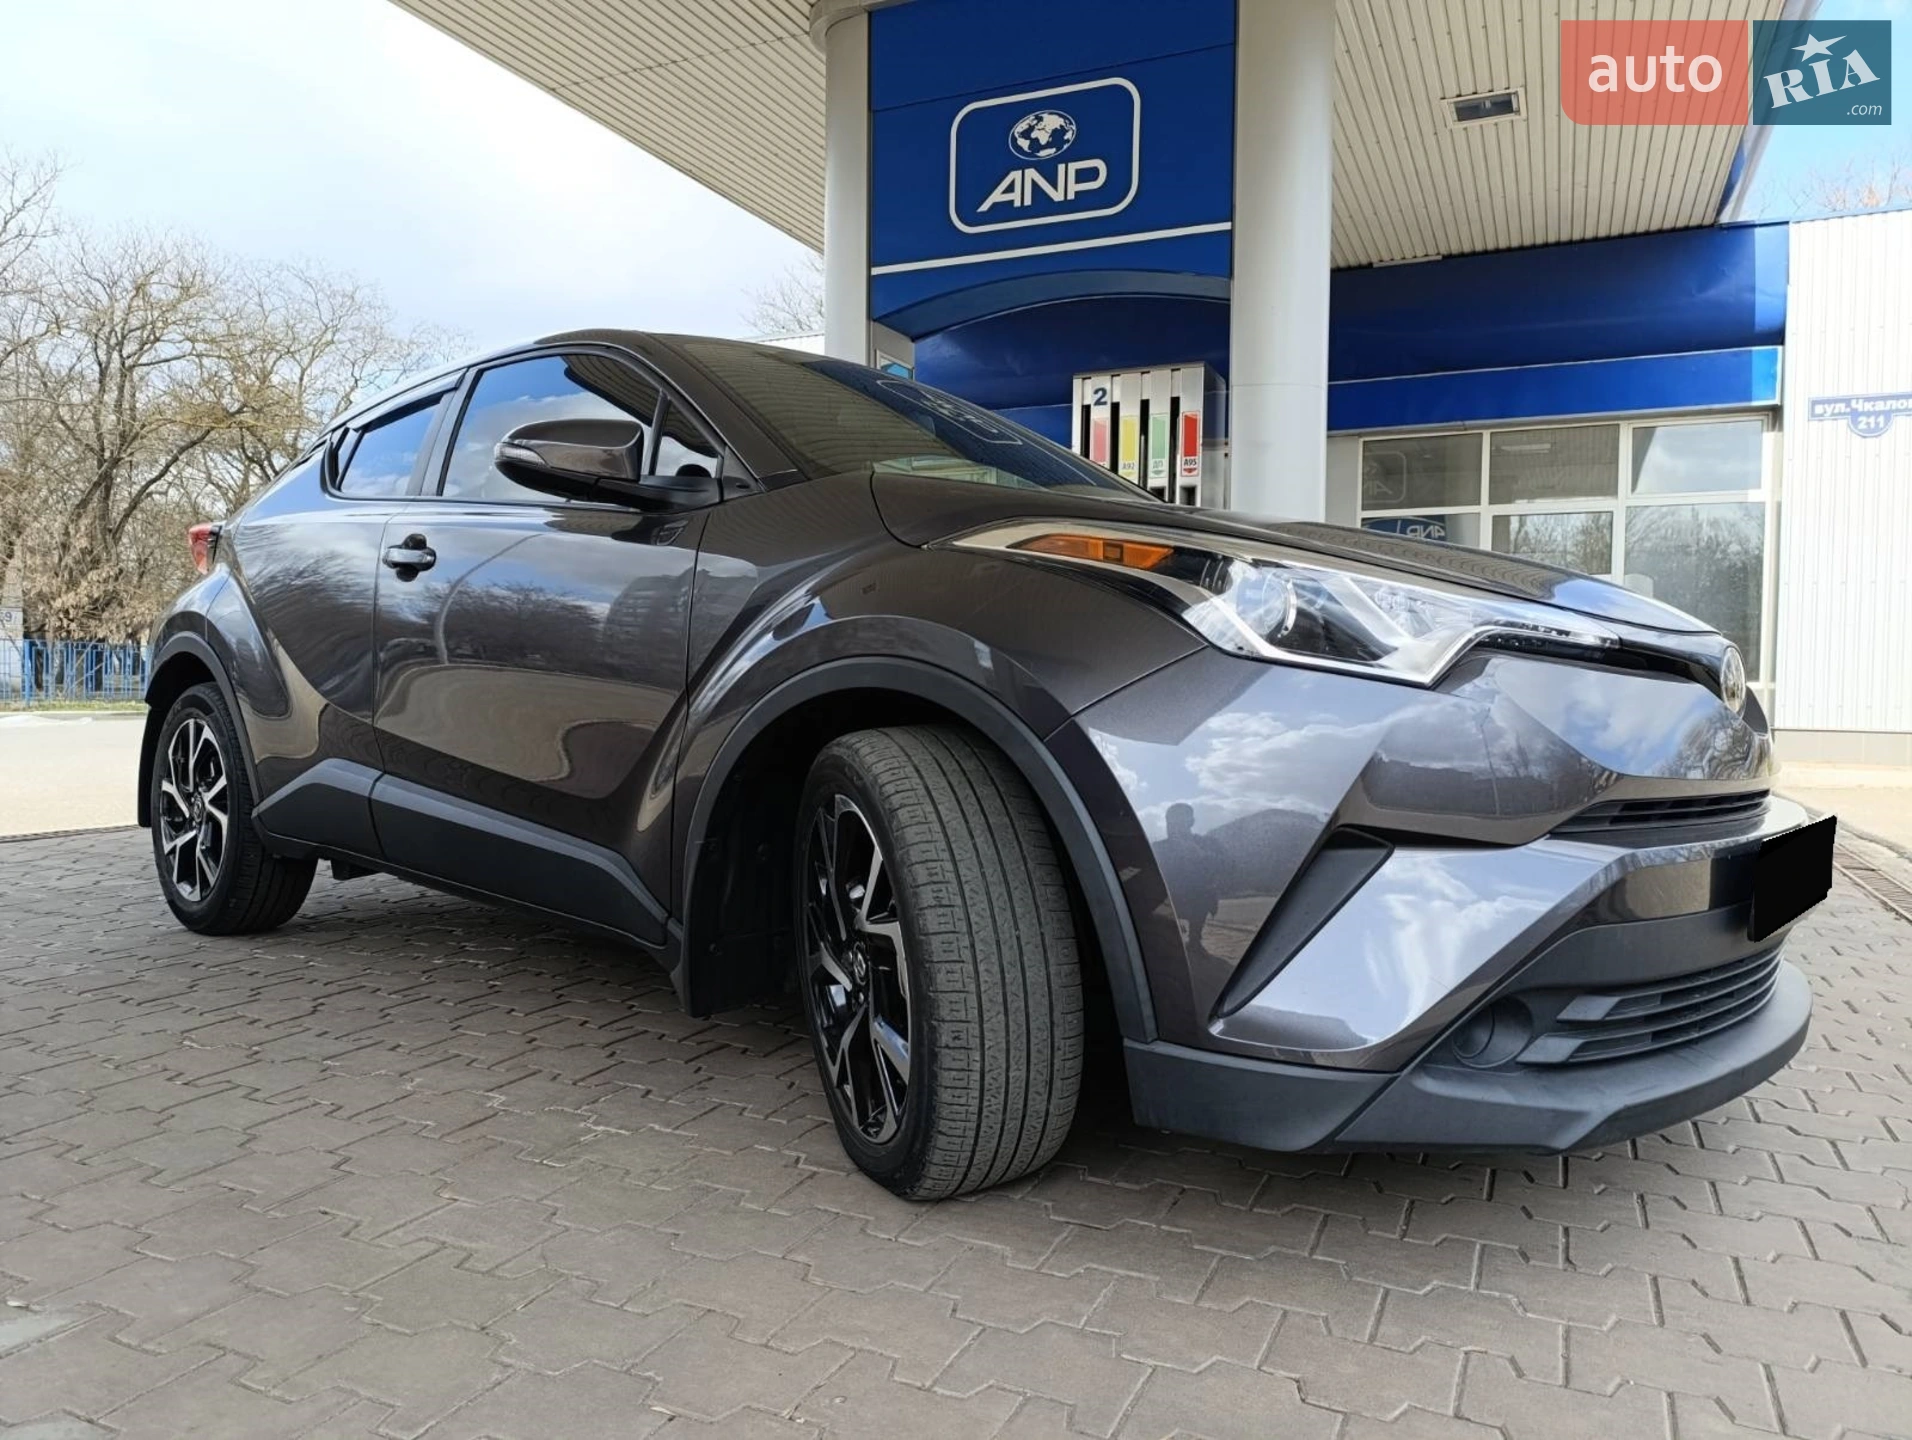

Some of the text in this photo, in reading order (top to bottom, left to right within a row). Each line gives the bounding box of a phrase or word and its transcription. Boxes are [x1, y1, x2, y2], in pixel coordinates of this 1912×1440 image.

[976, 158, 1108, 213] ANP
[1093, 387, 1108, 406] 2
[1857, 415, 1885, 430] 211
